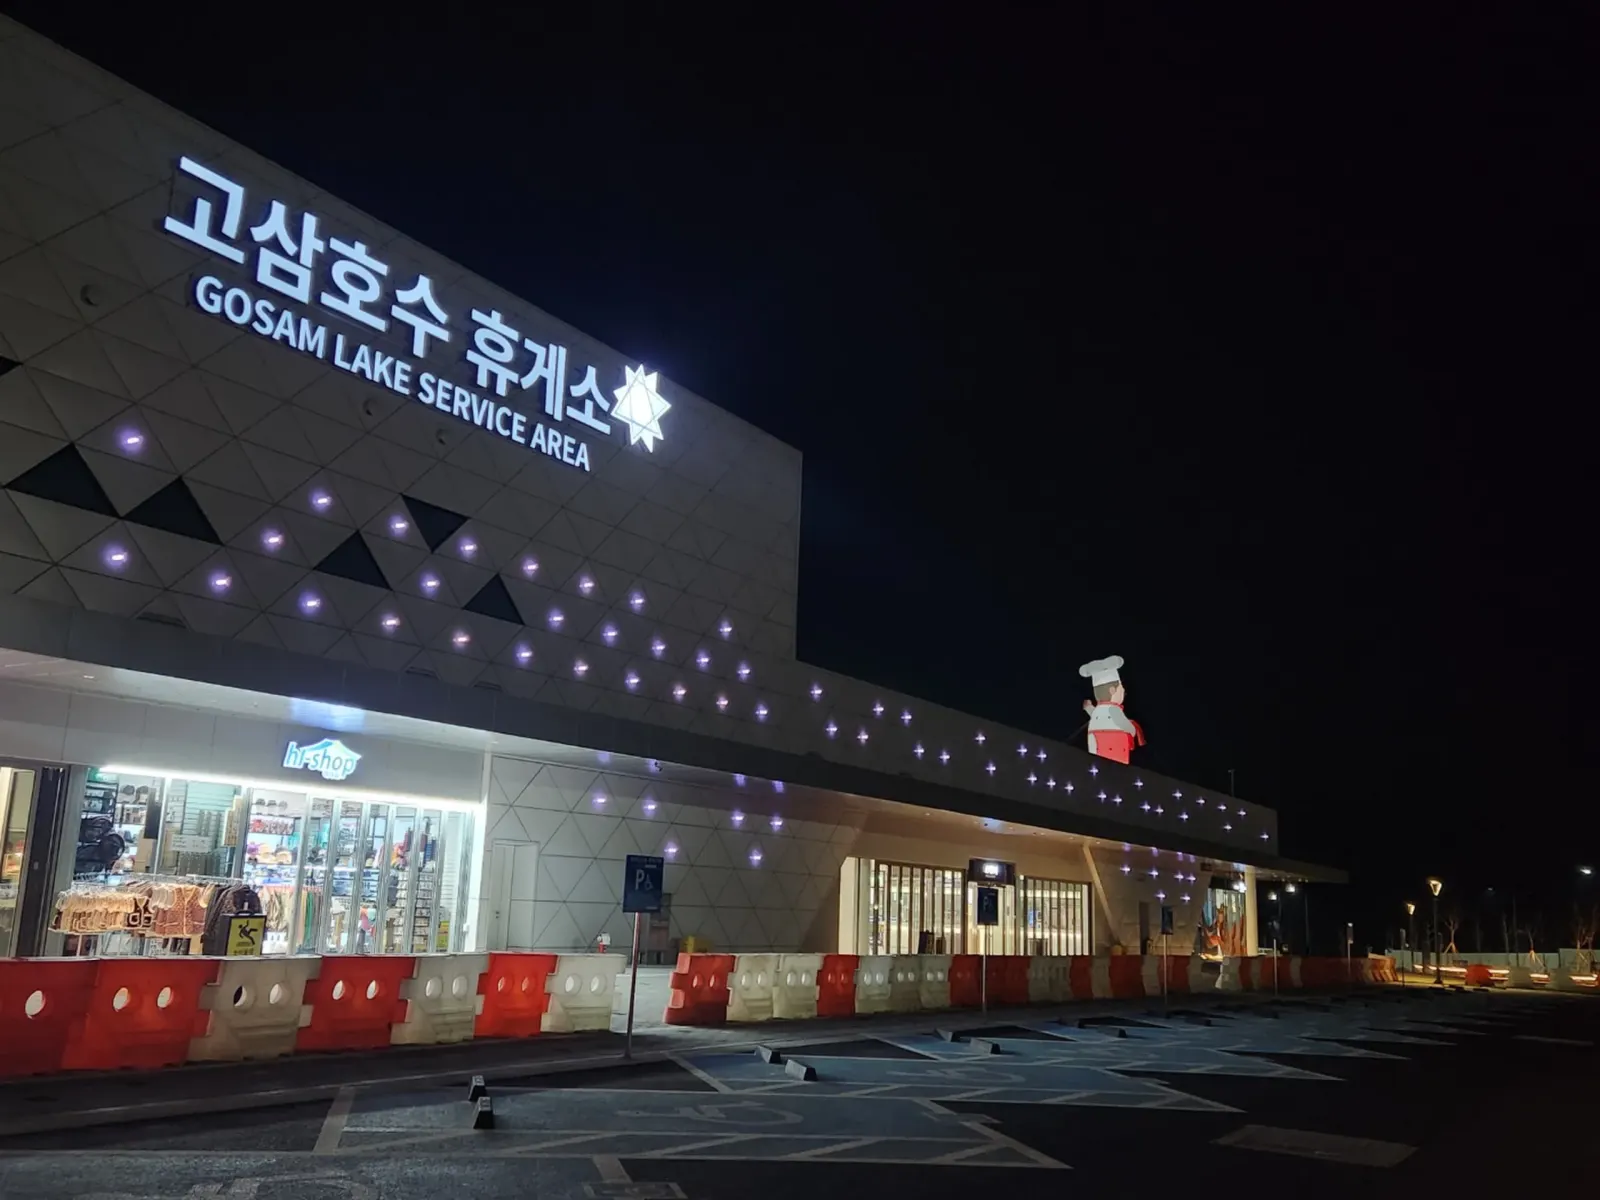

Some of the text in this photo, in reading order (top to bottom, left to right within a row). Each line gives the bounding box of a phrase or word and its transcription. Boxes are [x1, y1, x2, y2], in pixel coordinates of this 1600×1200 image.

[165, 157, 611, 434] 고삼호수 휴게소
[196, 276, 590, 471] GOSAM LAKE SERVICE AREA
[635, 869, 645, 891] P
